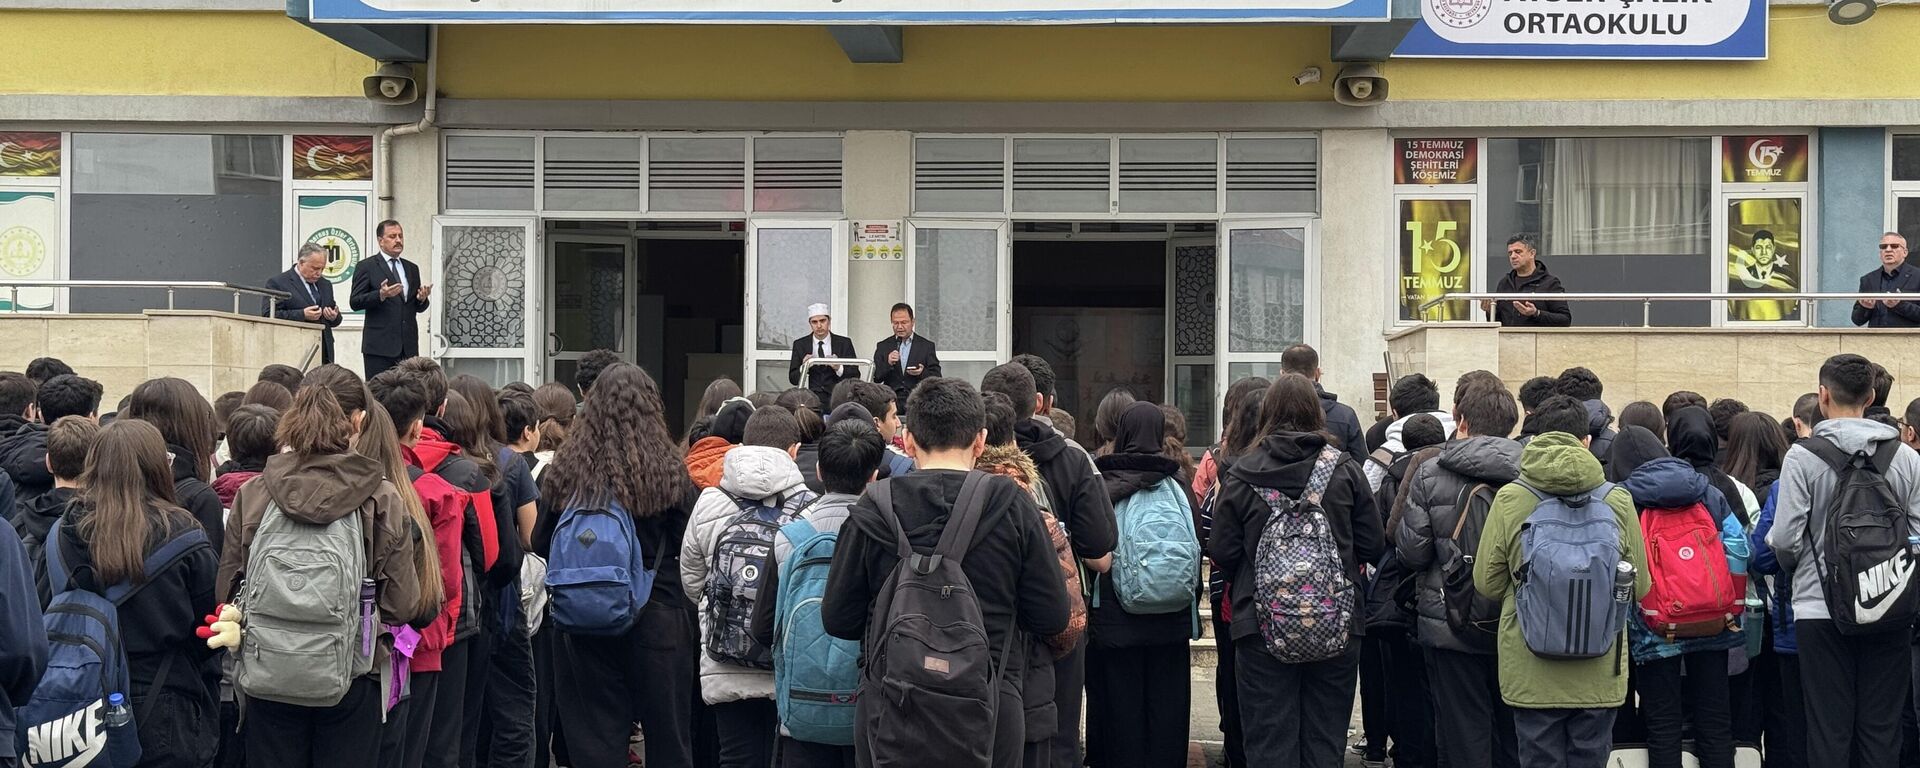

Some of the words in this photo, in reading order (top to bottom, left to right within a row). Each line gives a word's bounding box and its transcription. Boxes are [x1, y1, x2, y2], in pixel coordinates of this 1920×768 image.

[1504, 13, 1687, 35] ORTAOKULU
[1407, 141, 1418, 149] 15
[1420, 141, 1463, 149] TEMMUZ
[1405, 150, 1464, 160] DEMOKRASİ
[1410, 160, 1459, 170] ŞEHİTLERİ
[1412, 170, 1456, 180] KÖŞEMİZ
[1745, 168, 1782, 176] TEMMUZ
[1406, 221, 1462, 273] 15
[1403, 276, 1463, 289] TEMMUZ
[1858, 547, 1907, 603] NIKE
[27, 698, 105, 765] NIKE
